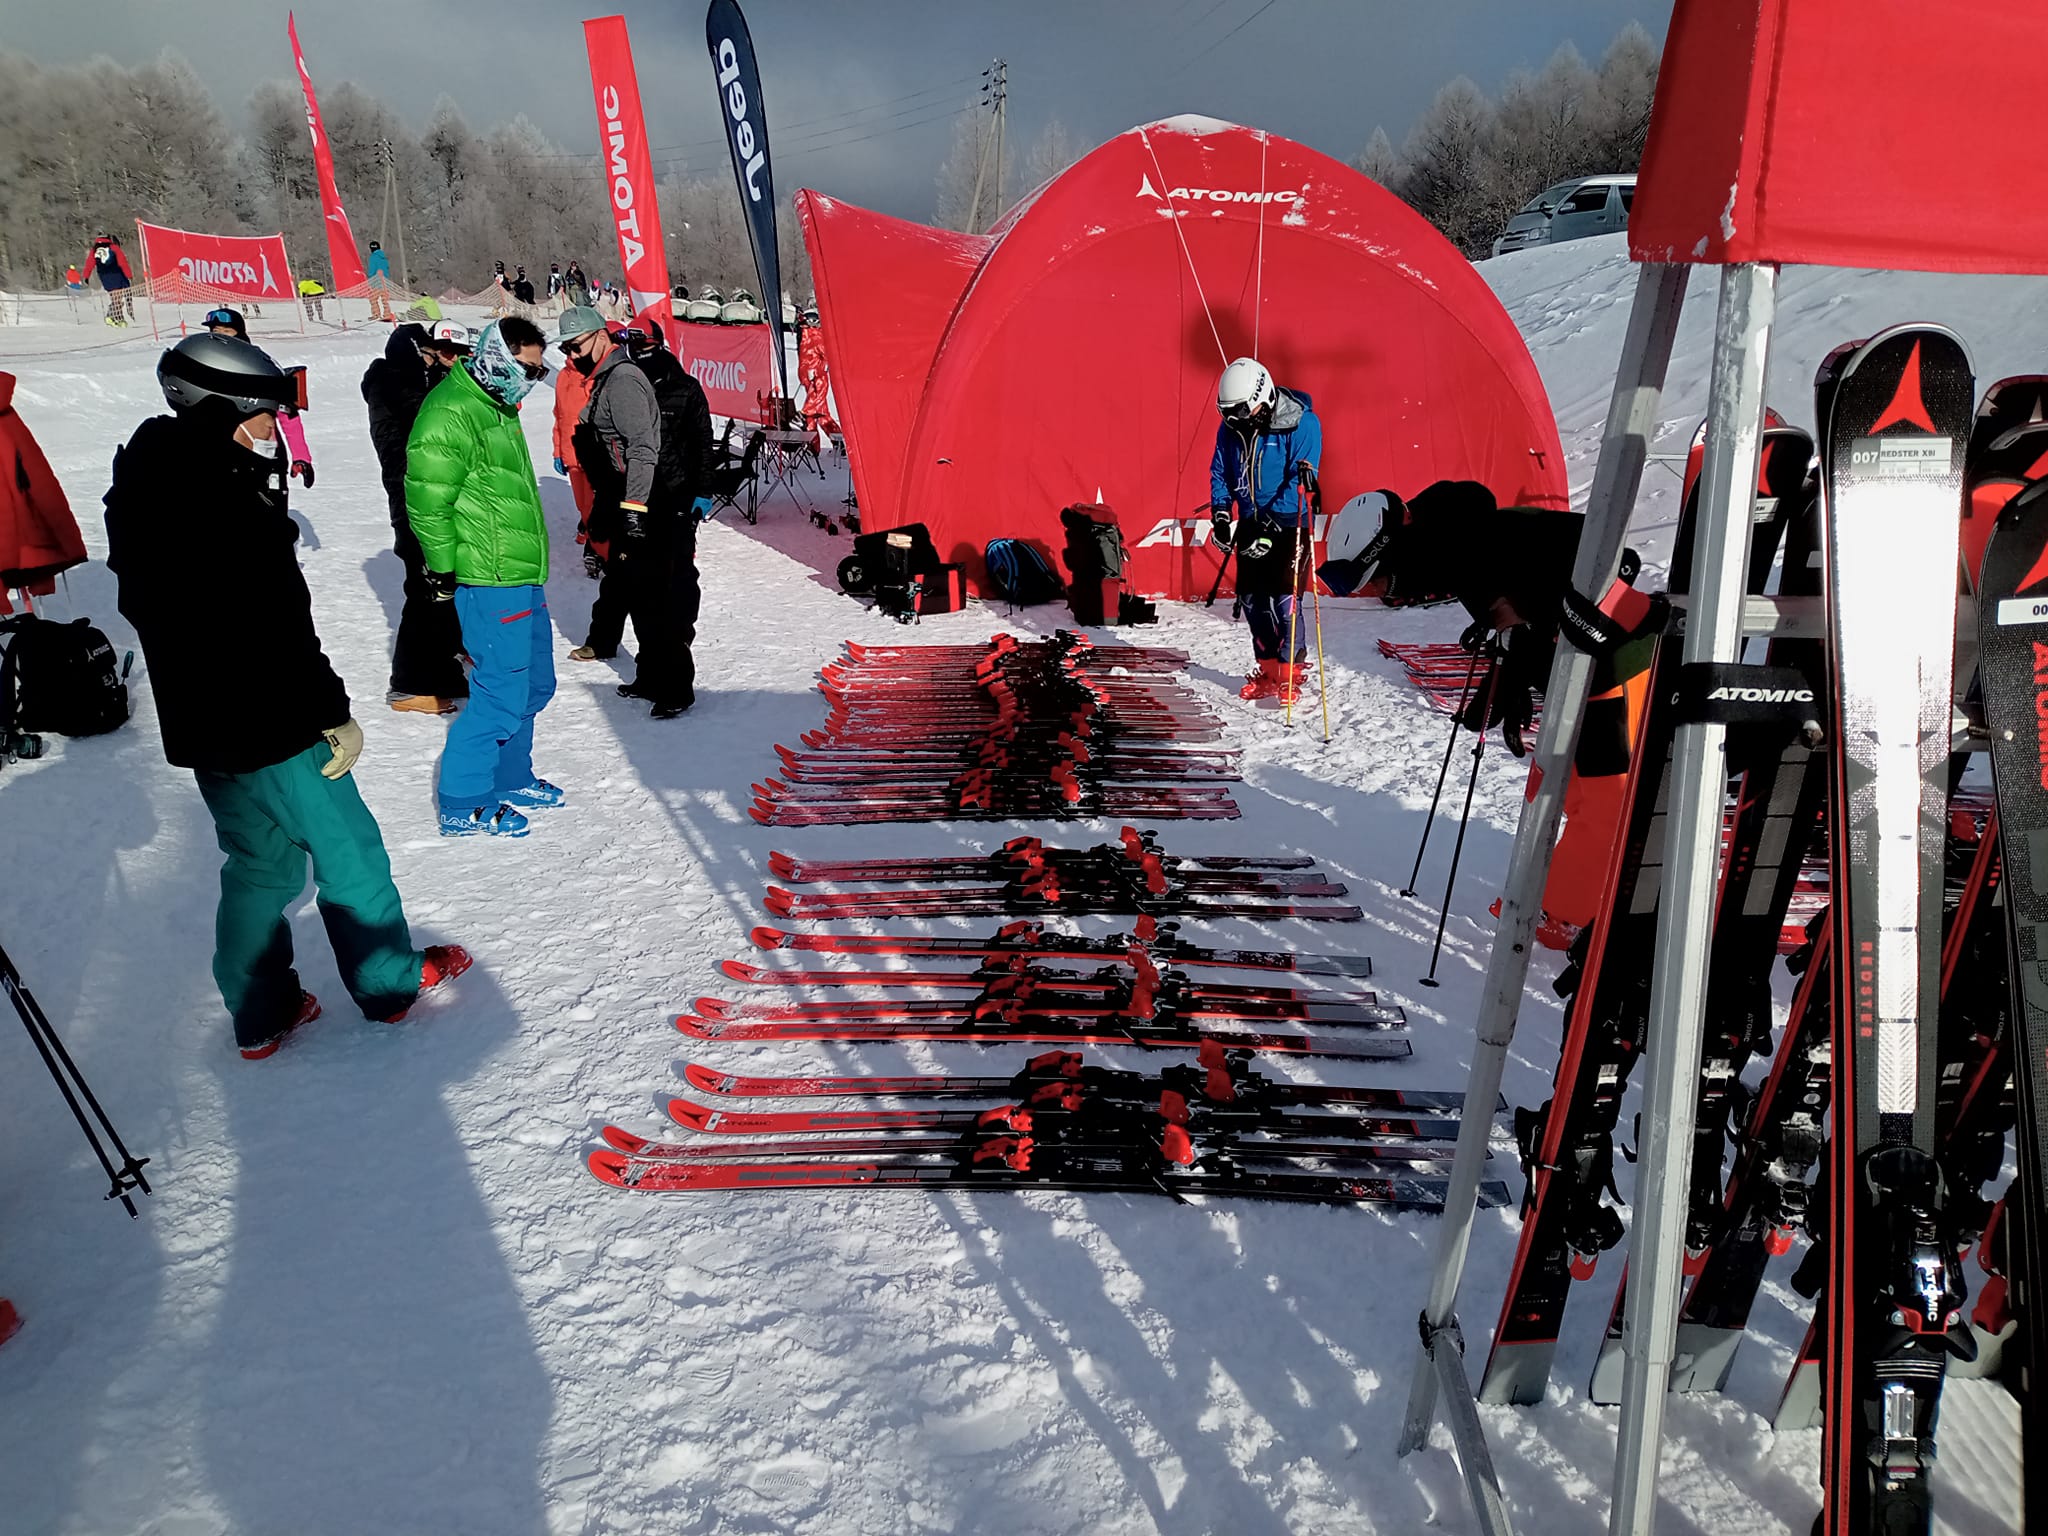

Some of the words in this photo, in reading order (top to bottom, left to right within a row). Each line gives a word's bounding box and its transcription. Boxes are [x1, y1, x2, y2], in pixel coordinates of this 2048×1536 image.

[1167, 187, 1298, 203] ATOMIC
[689, 358, 747, 393] ATOMIC
[1853, 451, 1878, 463] 007
[1706, 687, 1814, 702] ATOMIC
[1861, 941, 1873, 1037] REDSTER
[1635, 1016, 1645, 1046] ATOMIC
[1743, 1012, 1753, 1042] ATOMIC
